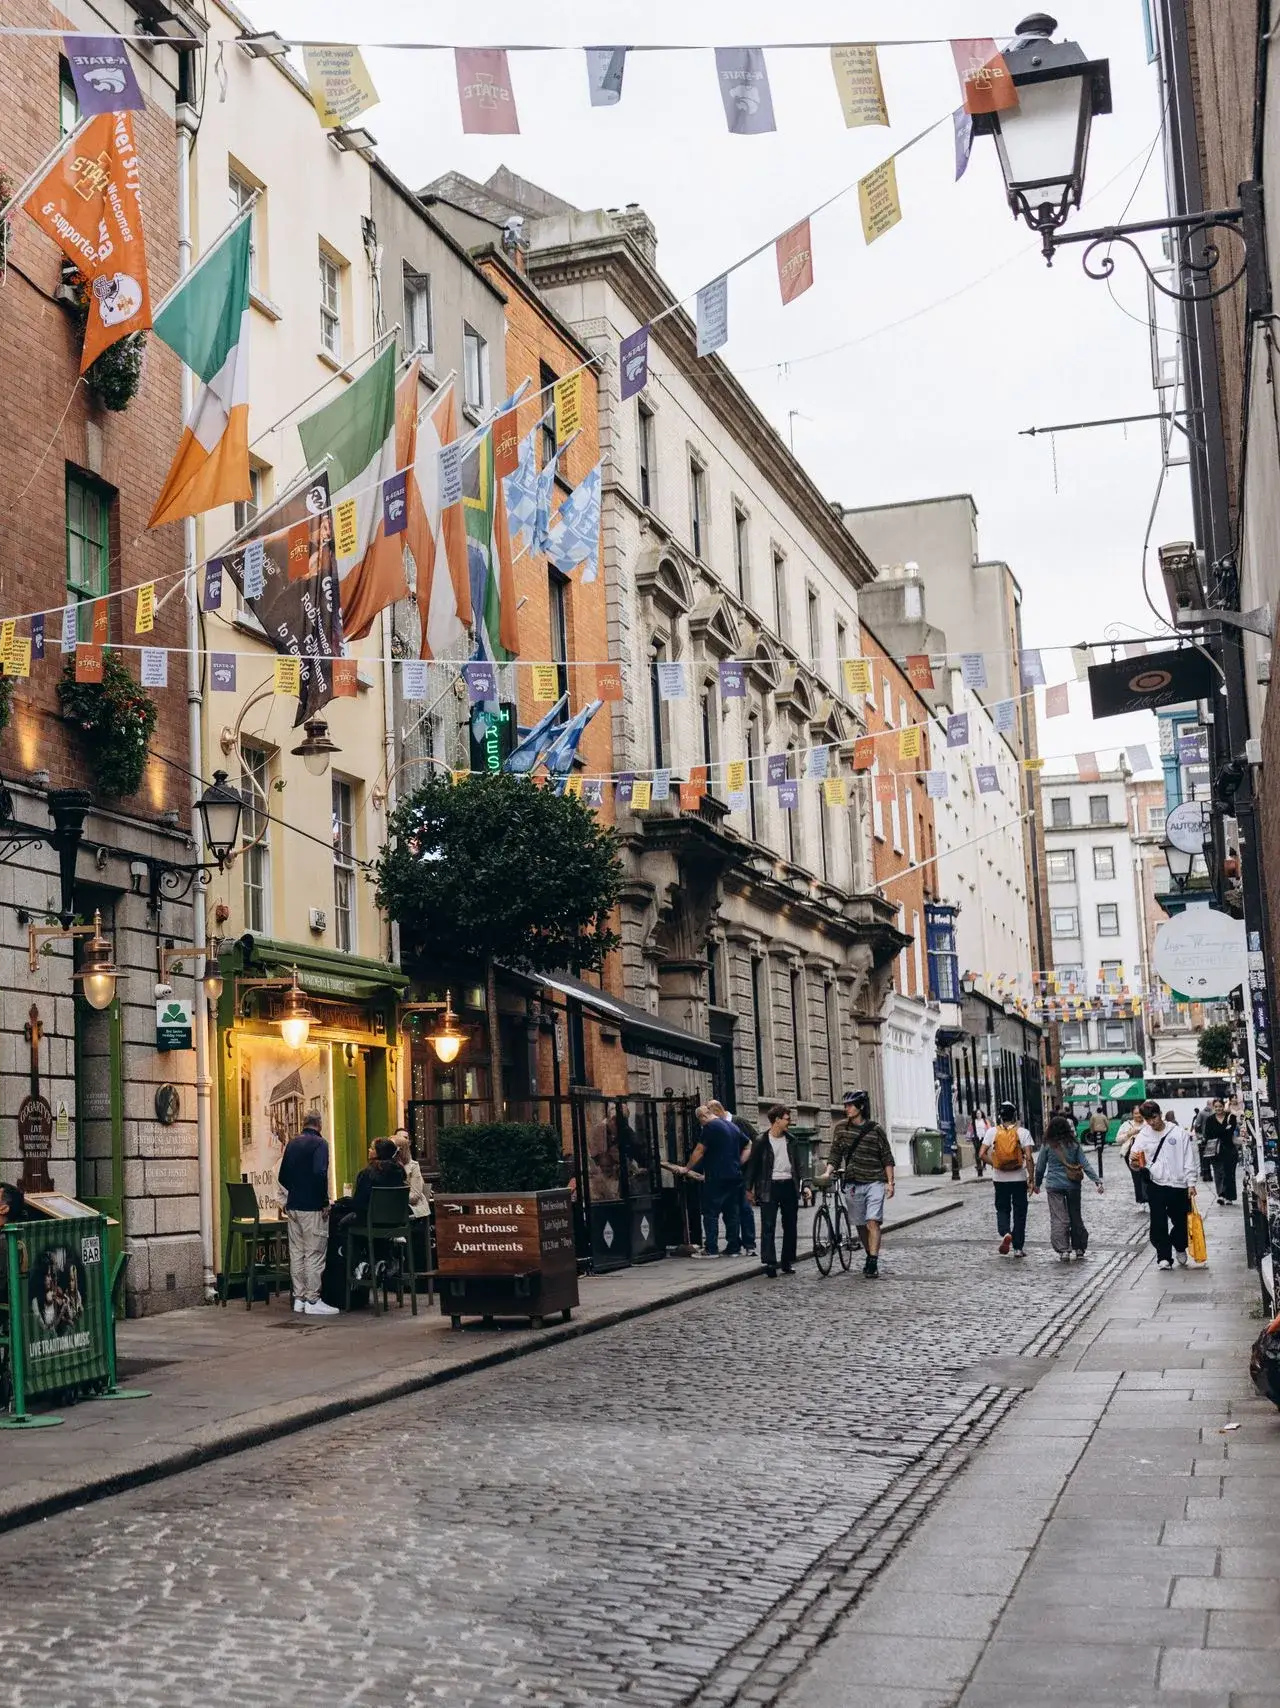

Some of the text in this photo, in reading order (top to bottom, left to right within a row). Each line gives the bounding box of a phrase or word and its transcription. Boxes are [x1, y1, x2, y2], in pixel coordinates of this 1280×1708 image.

[41, 202, 53, 216] &
[107, 182, 133, 243] Welcomes
[495, 437, 520, 457] STATE
[475, 1204, 525, 1215] Hostel &
[458, 1224, 518, 1233] Penthouse
[454, 1241, 523, 1253] Apartments
[83, 1248, 99, 1262] BAR
[29, 1331, 90, 1357] LIVE TRADITIONAL MUSIC
